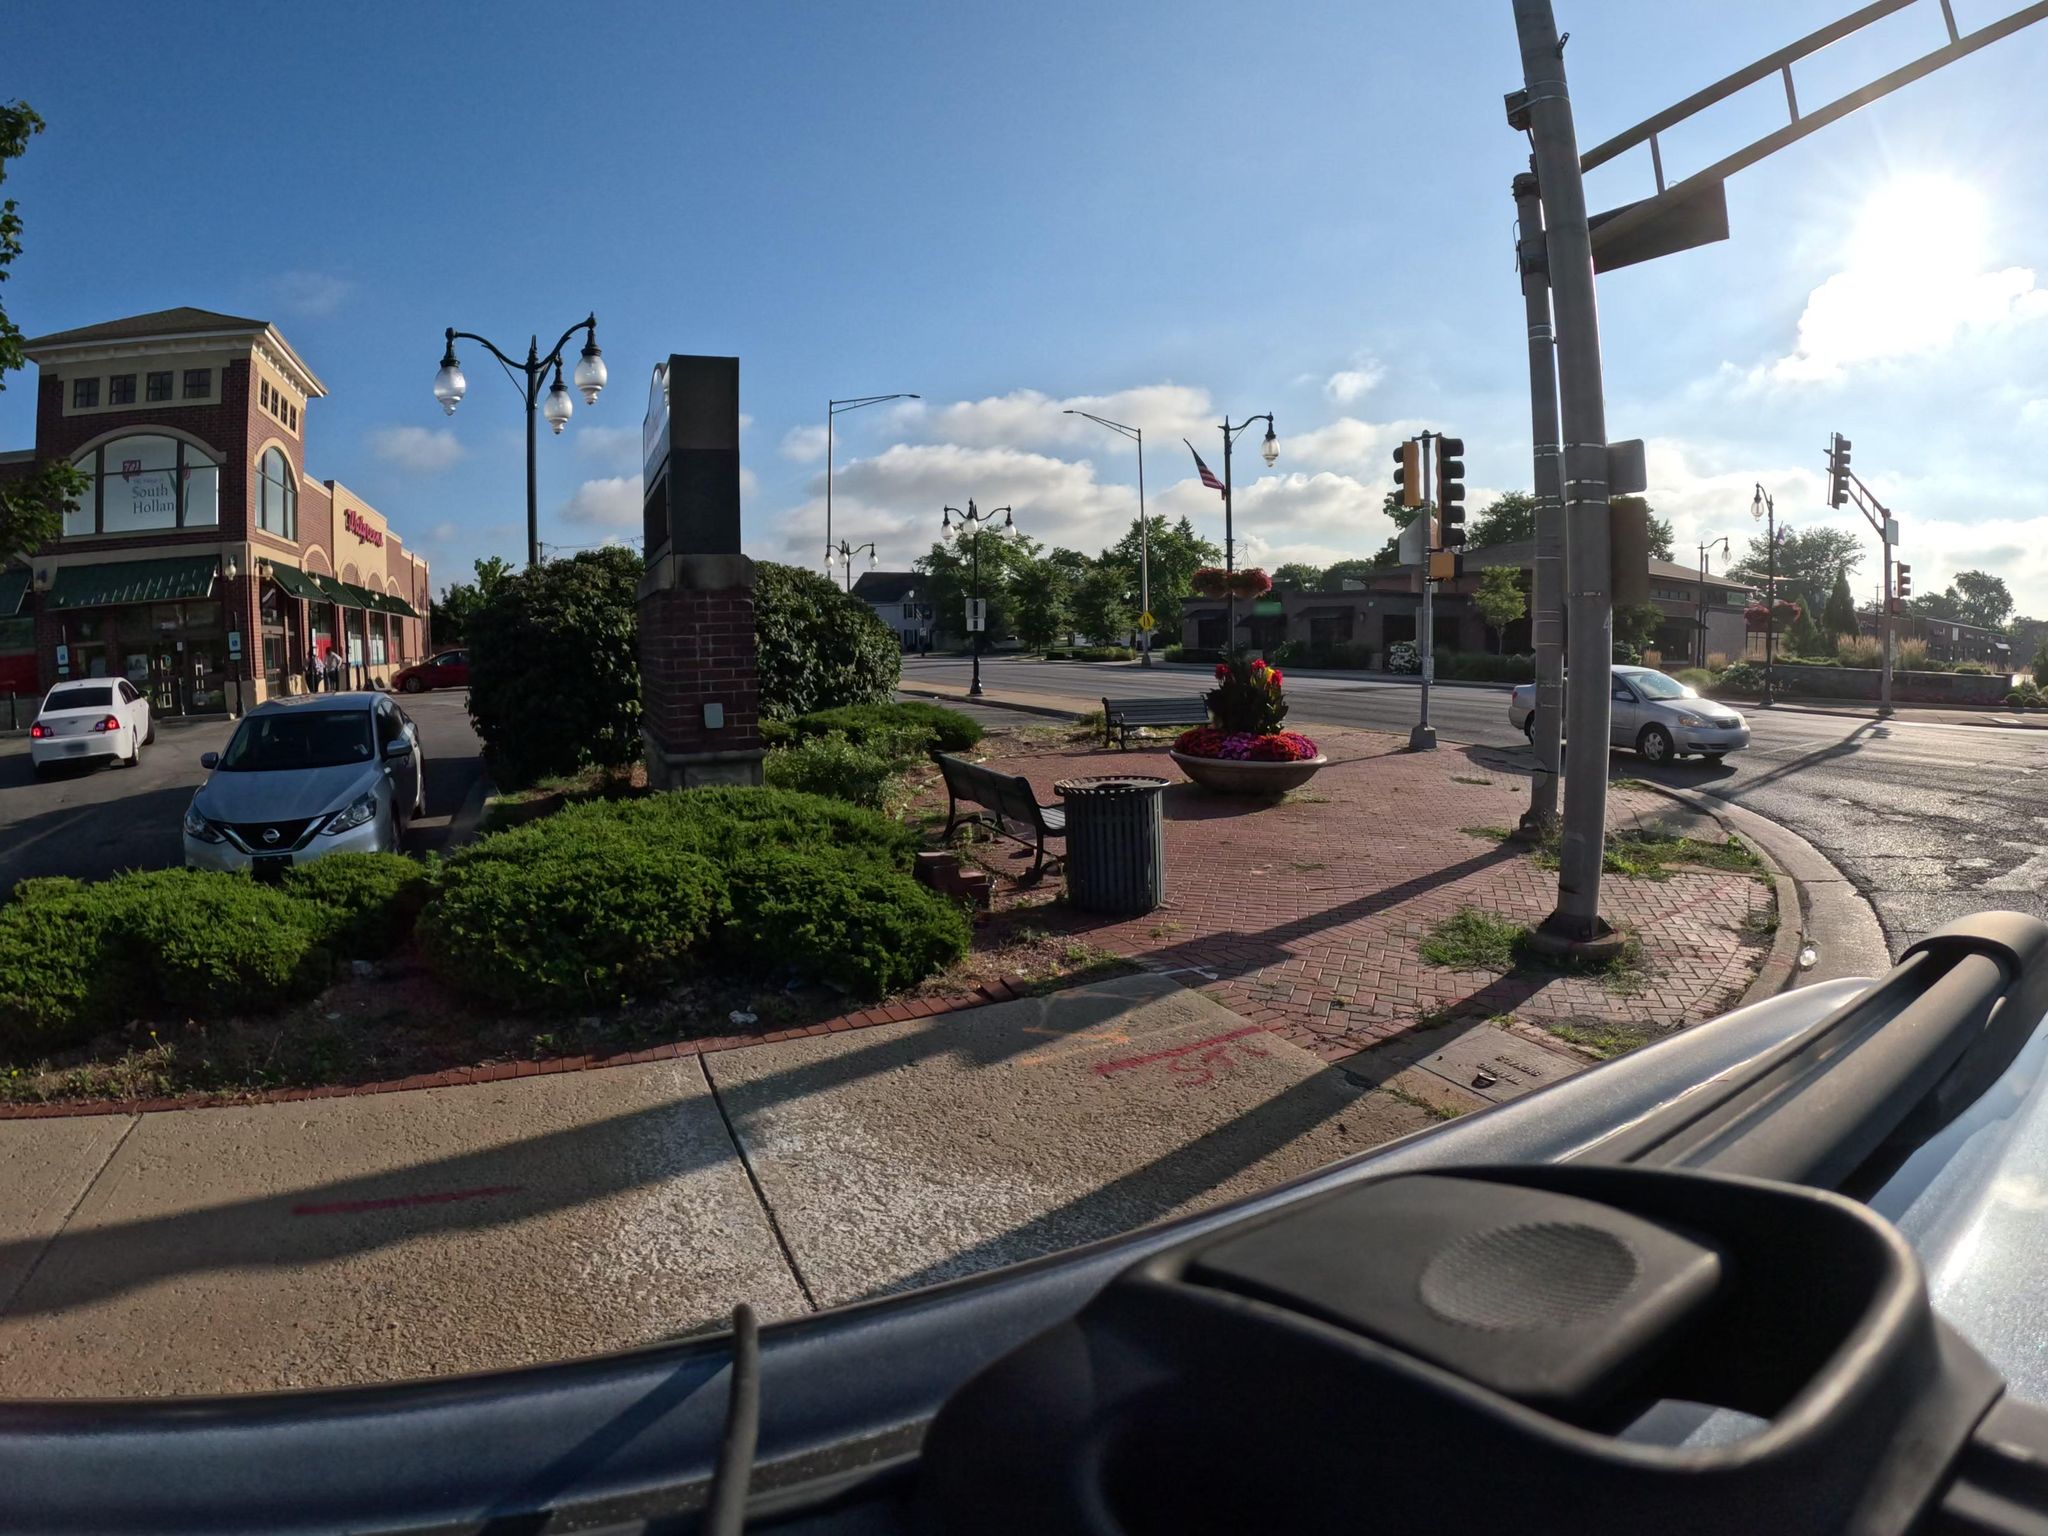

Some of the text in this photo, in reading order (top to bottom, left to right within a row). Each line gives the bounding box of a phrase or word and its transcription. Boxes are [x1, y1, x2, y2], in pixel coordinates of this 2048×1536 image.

[132, 483, 168, 499] South
[133, 499, 176, 514] Hollan
[344, 508, 384, 548] Walgreens
